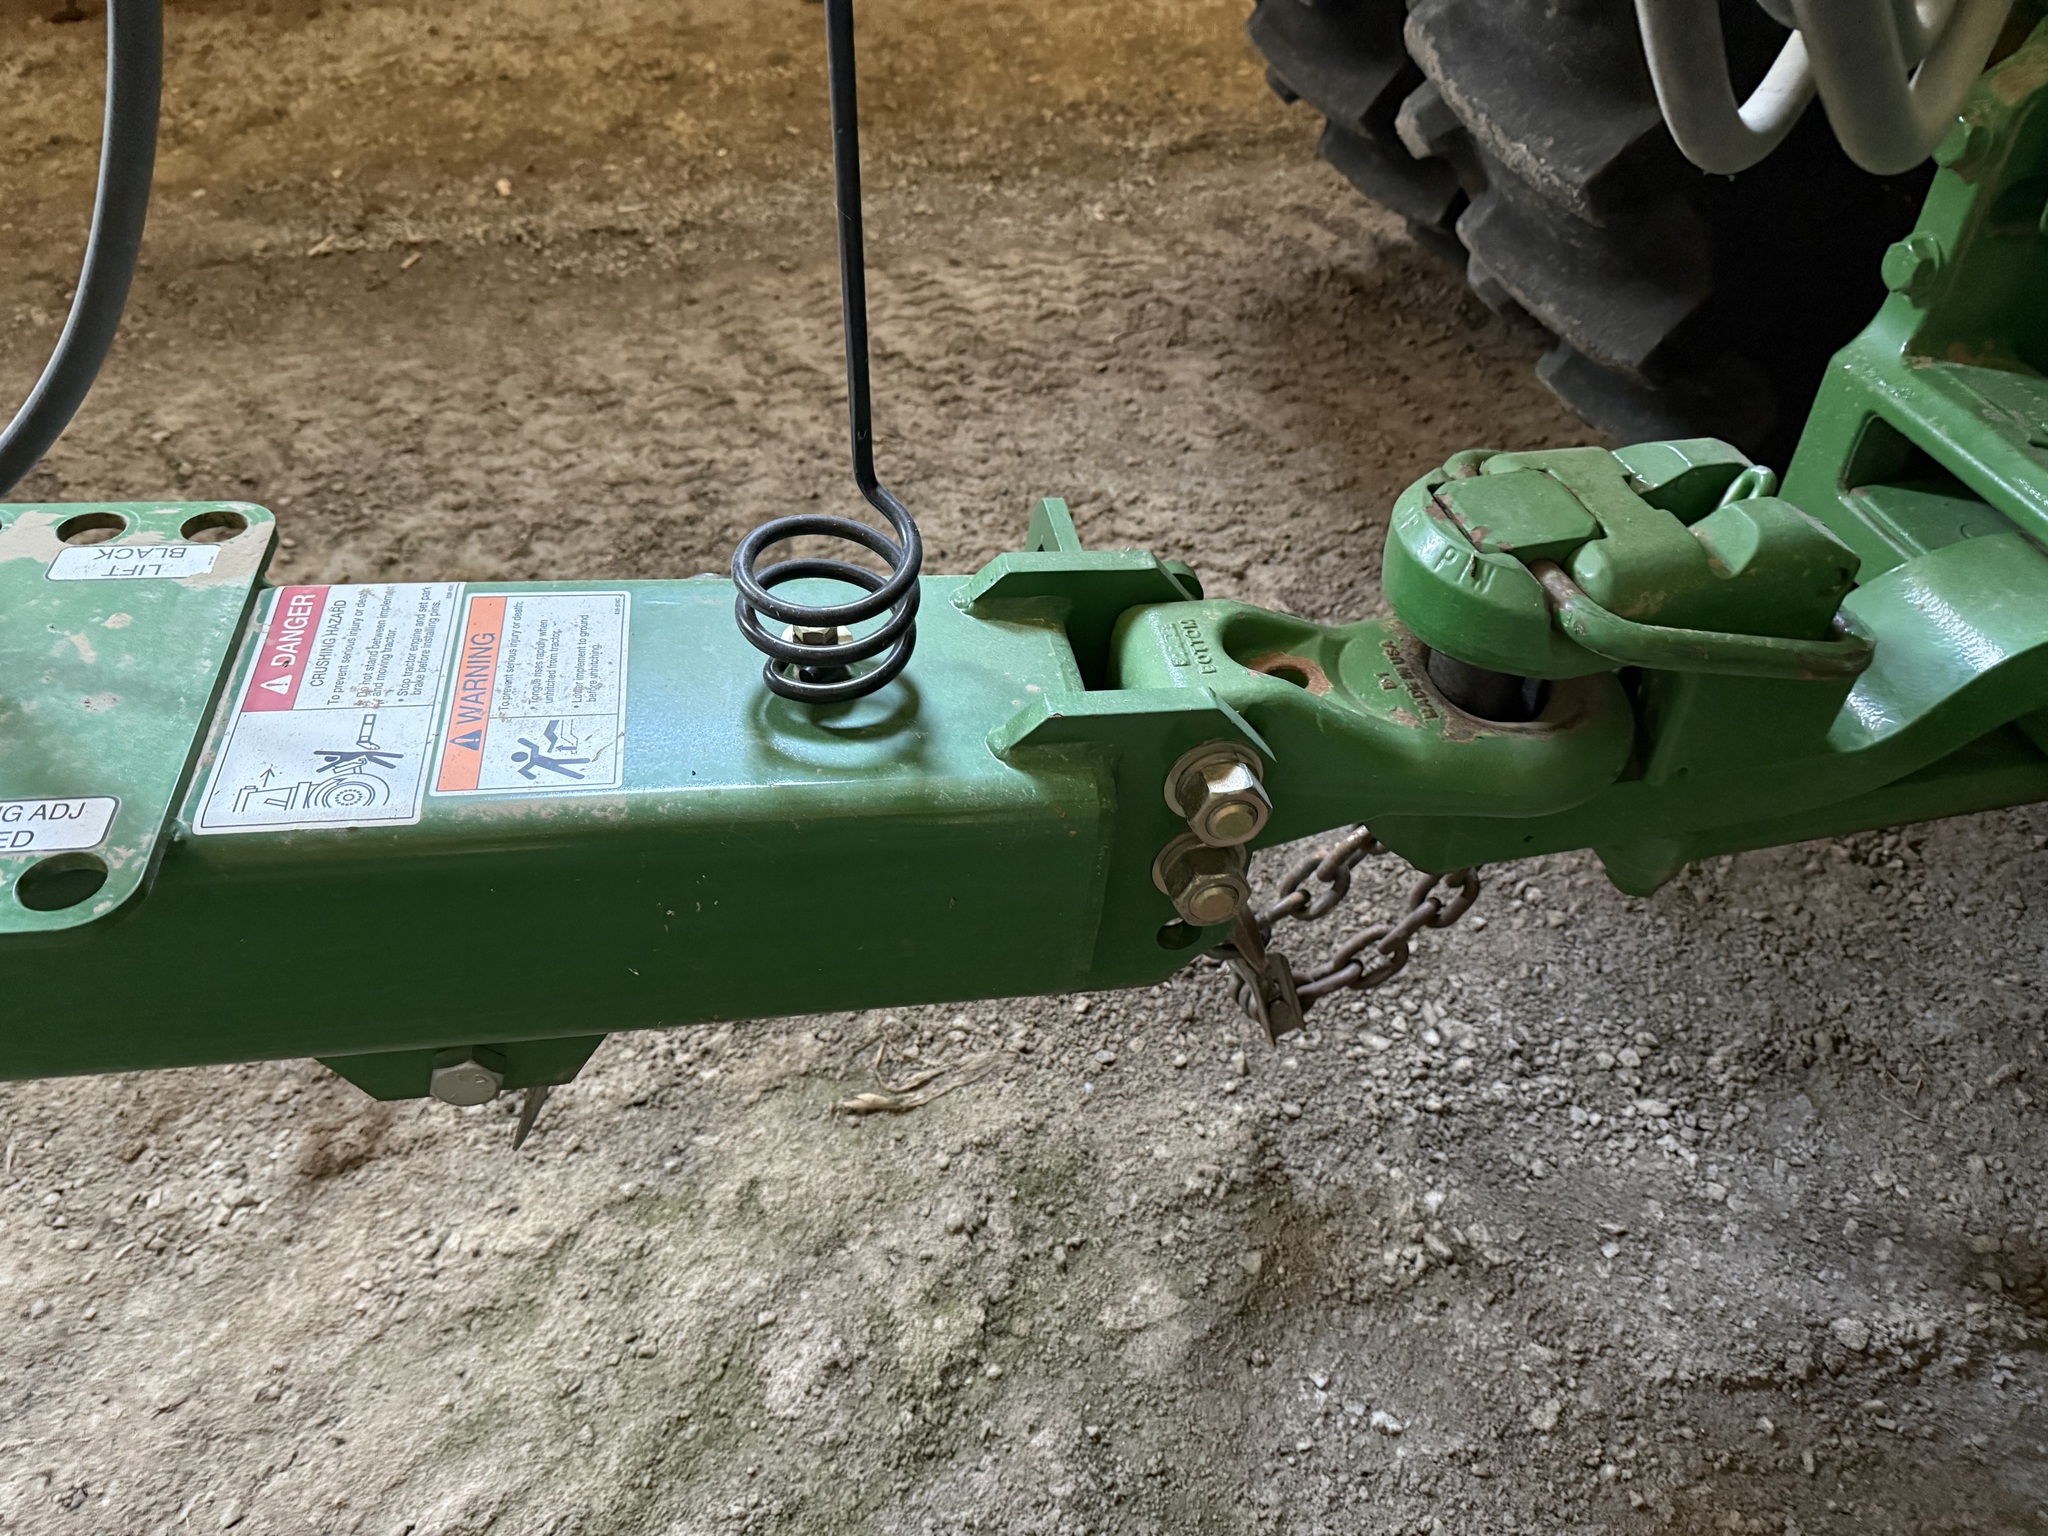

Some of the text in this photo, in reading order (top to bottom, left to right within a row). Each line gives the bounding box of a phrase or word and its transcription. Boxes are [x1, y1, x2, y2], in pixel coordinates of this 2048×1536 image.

[92, 547, 187, 560] BLACK
[100, 564, 161, 577] LIFT
[270, 595, 316, 667] DANGER
[310, 600, 347, 687] CRUSHING HAZARD
[327, 590, 369, 706] To prevent serious injury or deat
[356, 586, 394, 698] Do not stand between impleme
[396, 586, 432, 697] Stop tractor engine and set park
[410, 600, 441, 696] brake before installing pins.
[507, 629, 521, 648] injury
[577, 637, 587, 645] to
[579, 615, 589, 637] ground
[1180, 619, 1217, 675] BOTTOM
[372, 628, 397, 697] and moving tractor.
[455, 633, 496, 725] WARNING
[503, 649, 517, 673] serious
[528, 620, 548, 705] Tongue rises rapidly when
[546, 653, 558, 669] from
[575, 646, 587, 681] implement
[585, 643, 602, 703] before unhitching.
[1379, 640, 1439, 721] MADE IN USA
[498, 702, 510, 711] To
[501, 674, 513, 700] prevent
[545, 670, 556, 704] unhitched
[0, 801, 87, 823] G ADJ
